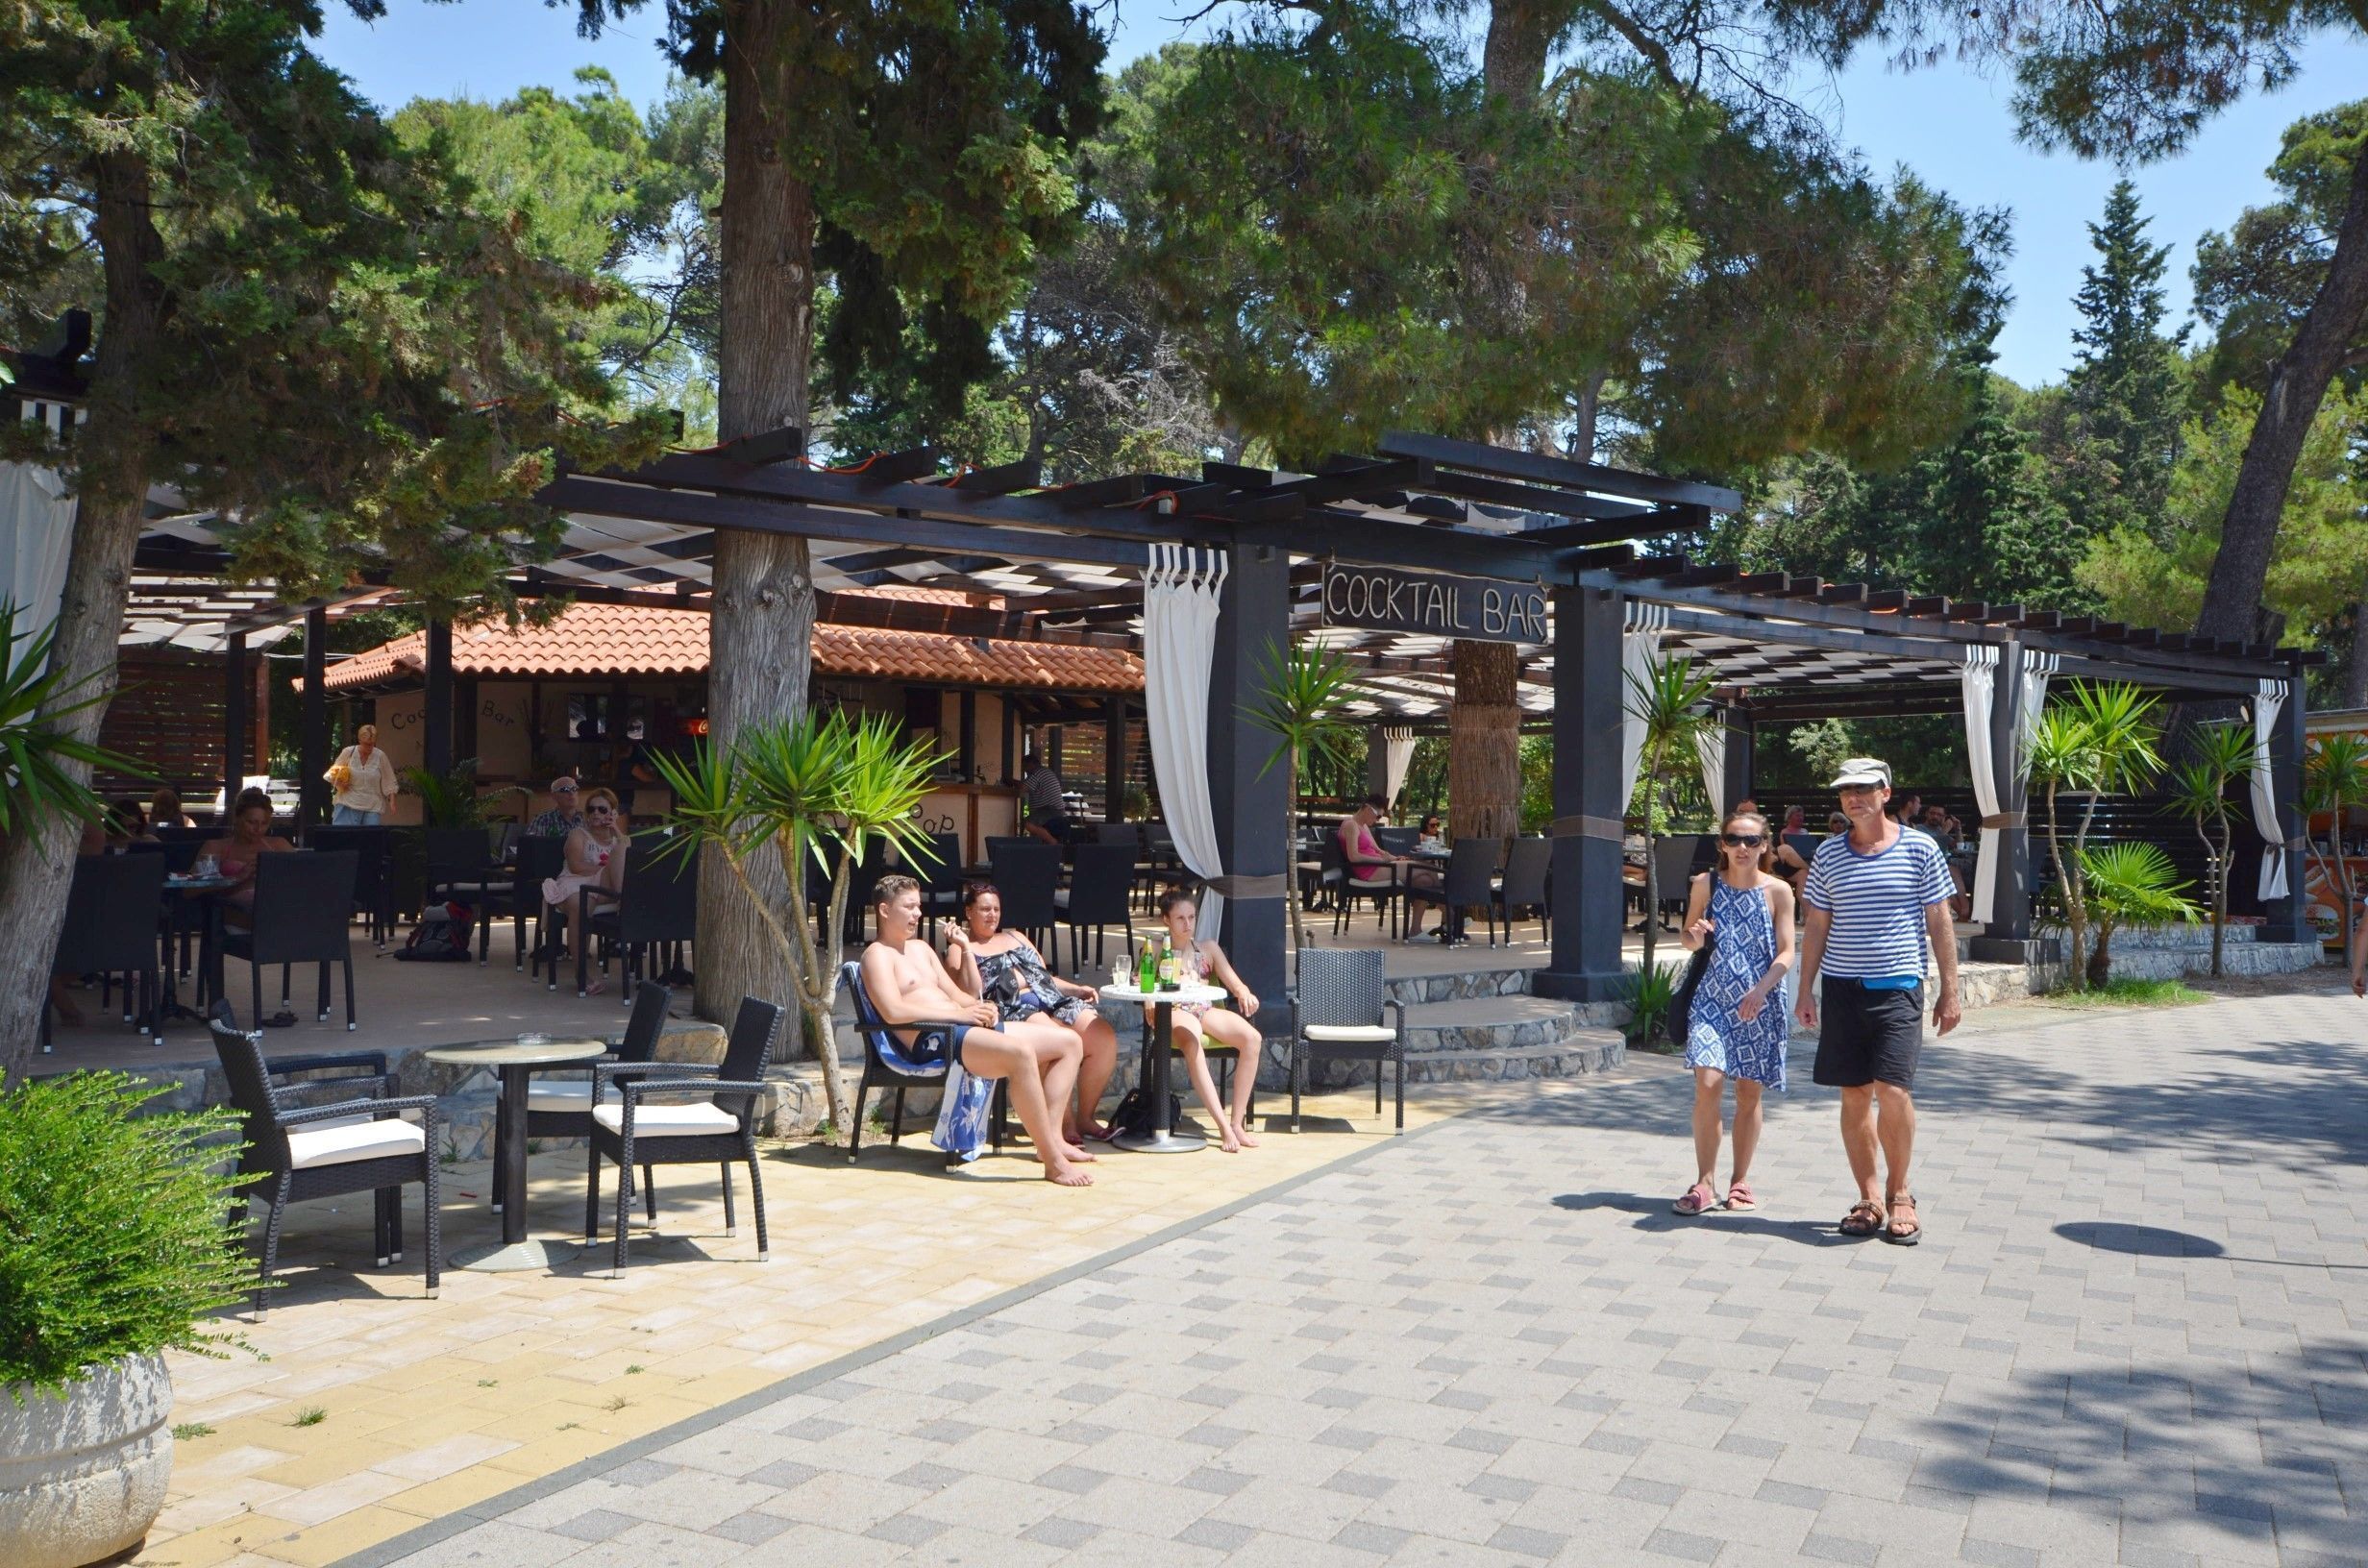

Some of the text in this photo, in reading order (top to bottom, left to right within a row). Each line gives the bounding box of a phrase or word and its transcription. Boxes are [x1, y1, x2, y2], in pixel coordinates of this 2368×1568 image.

[1327, 572, 1547, 639] COCKTAIL BAR
[481, 699, 515, 727] Bar
